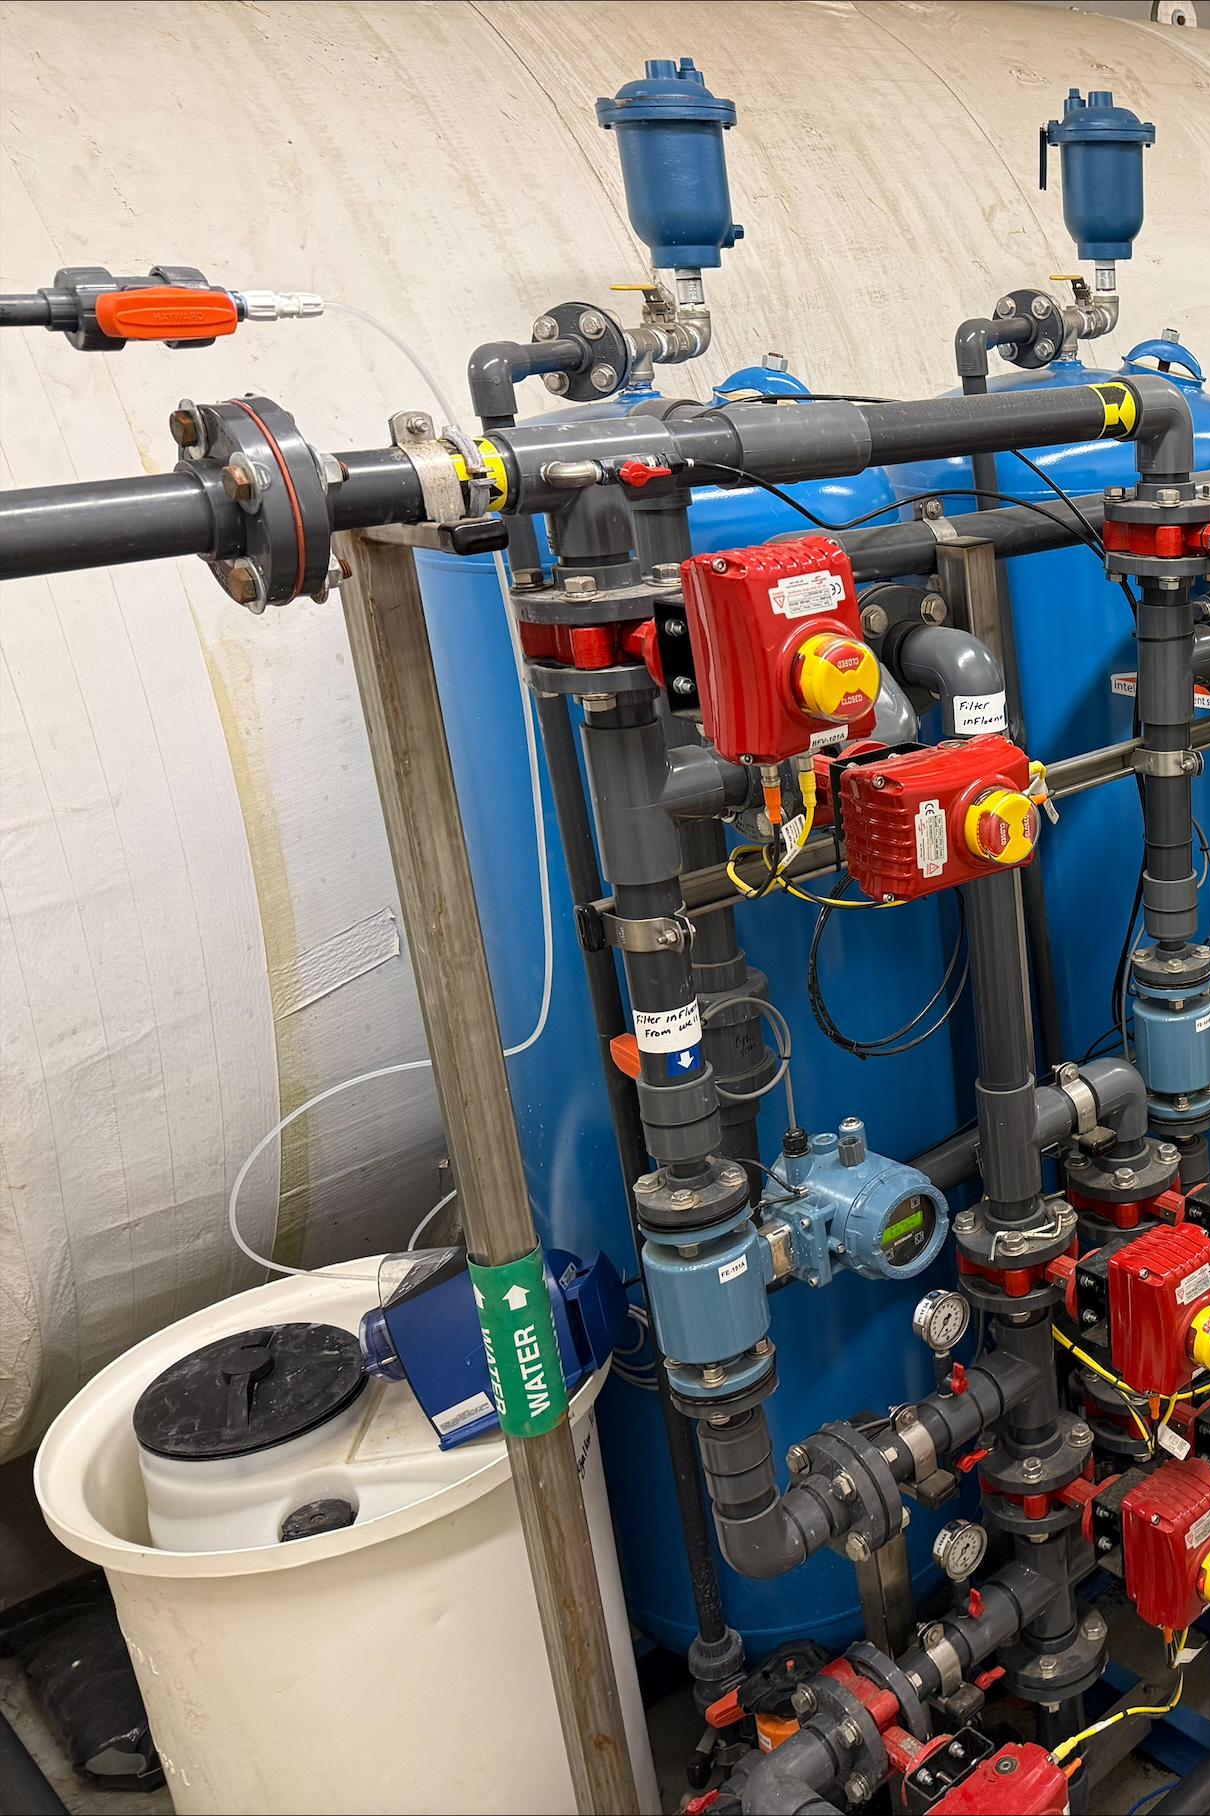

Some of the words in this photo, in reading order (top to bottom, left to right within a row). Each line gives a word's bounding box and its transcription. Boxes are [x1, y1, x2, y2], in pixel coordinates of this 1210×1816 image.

[837, 656, 860, 670] CLOSED
[840, 693, 864, 706] CLOSED
[959, 702, 991, 711] Filter
[811, 732, 846, 748] BFV-101A
[636, 1014, 662, 1025] Filter
[645, 1028, 672, 1038] From
[513, 1323, 551, 1418] WATER
